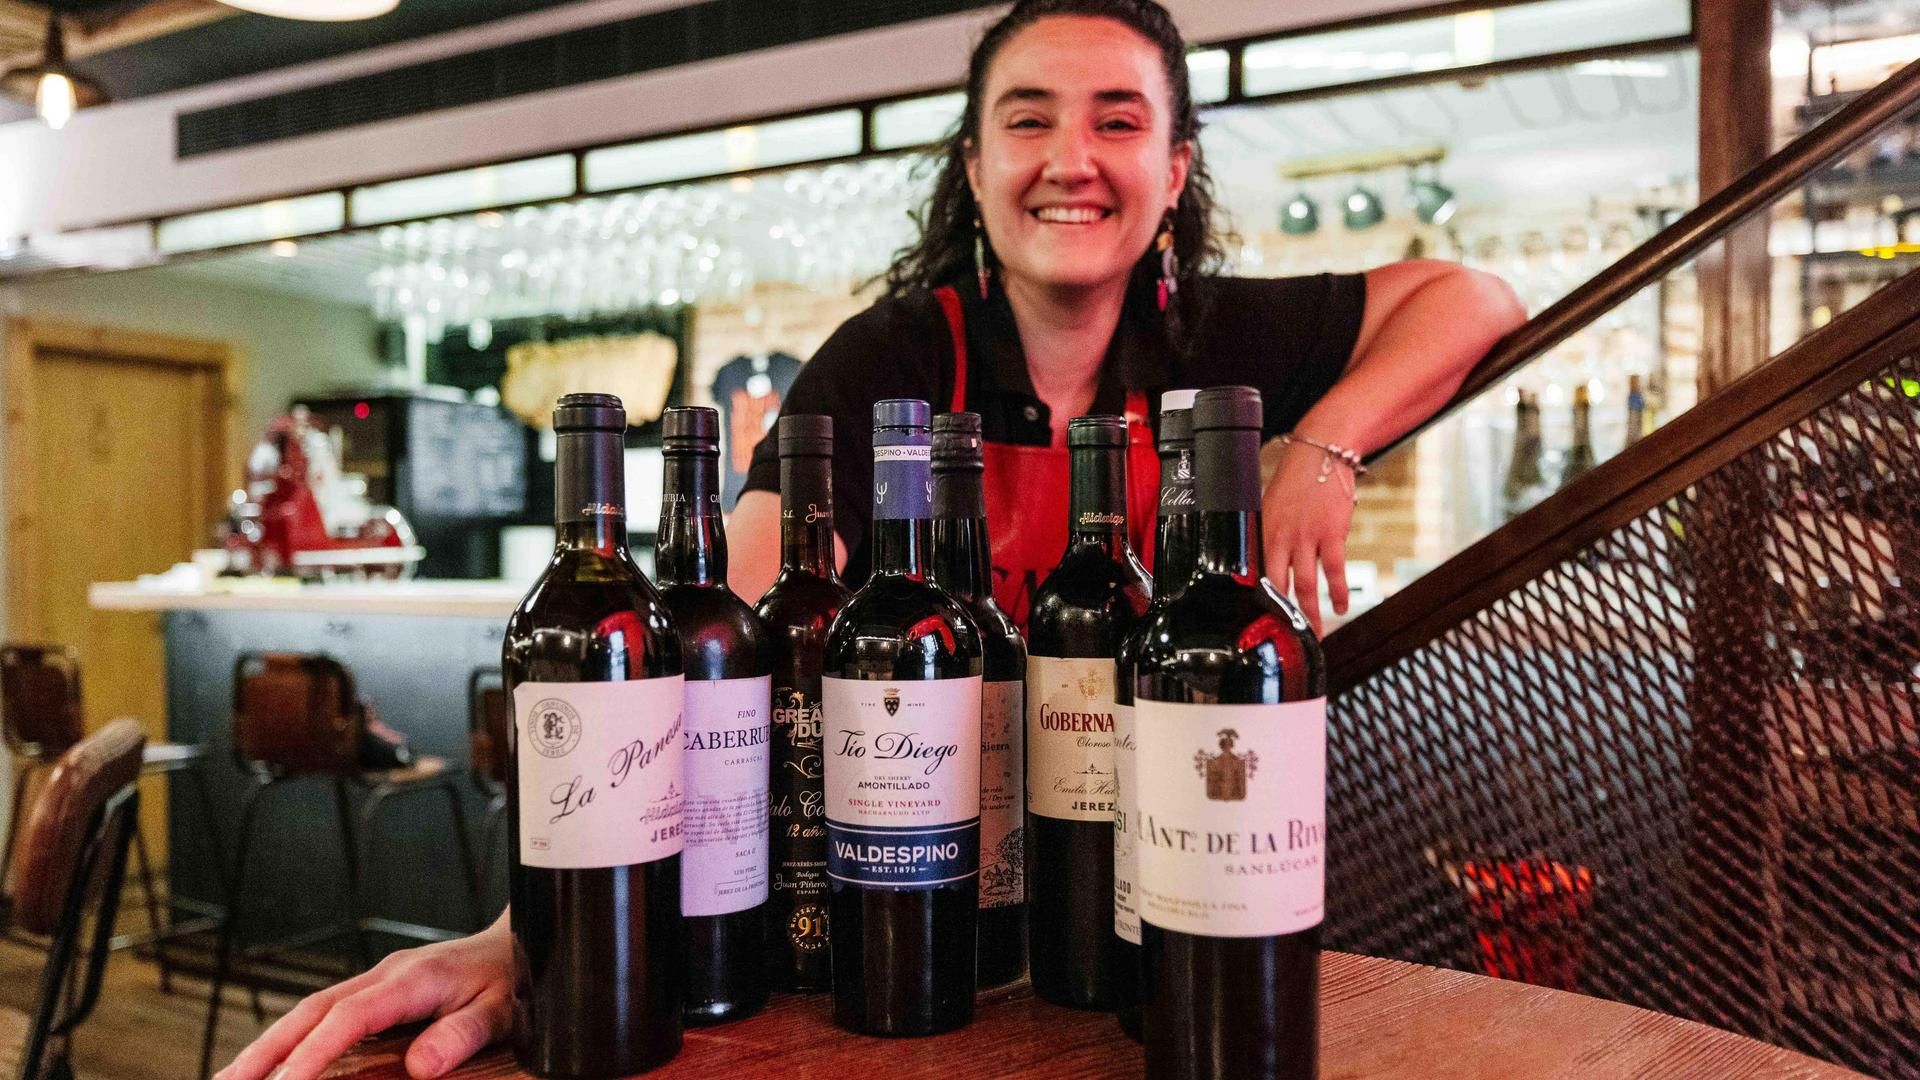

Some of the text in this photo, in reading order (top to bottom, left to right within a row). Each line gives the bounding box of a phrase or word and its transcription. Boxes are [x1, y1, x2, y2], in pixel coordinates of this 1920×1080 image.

[1079, 512, 1125, 526] Hidalgo
[737, 709, 757, 719] FINO
[873, 732, 958, 776] Diego
[857, 781, 930, 791] AMONTILLADO
[550, 774, 597, 825] La
[848, 798, 941, 808] SINGLE VINEYARD
[1071, 801, 1115, 812] JEREZ
[1207, 832, 1240, 854] DE
[1250, 832, 1277, 854] LA
[835, 841, 959, 863] VALDESPINO
[773, 873, 797, 890] Juan
[798, 916, 824, 938] 91
